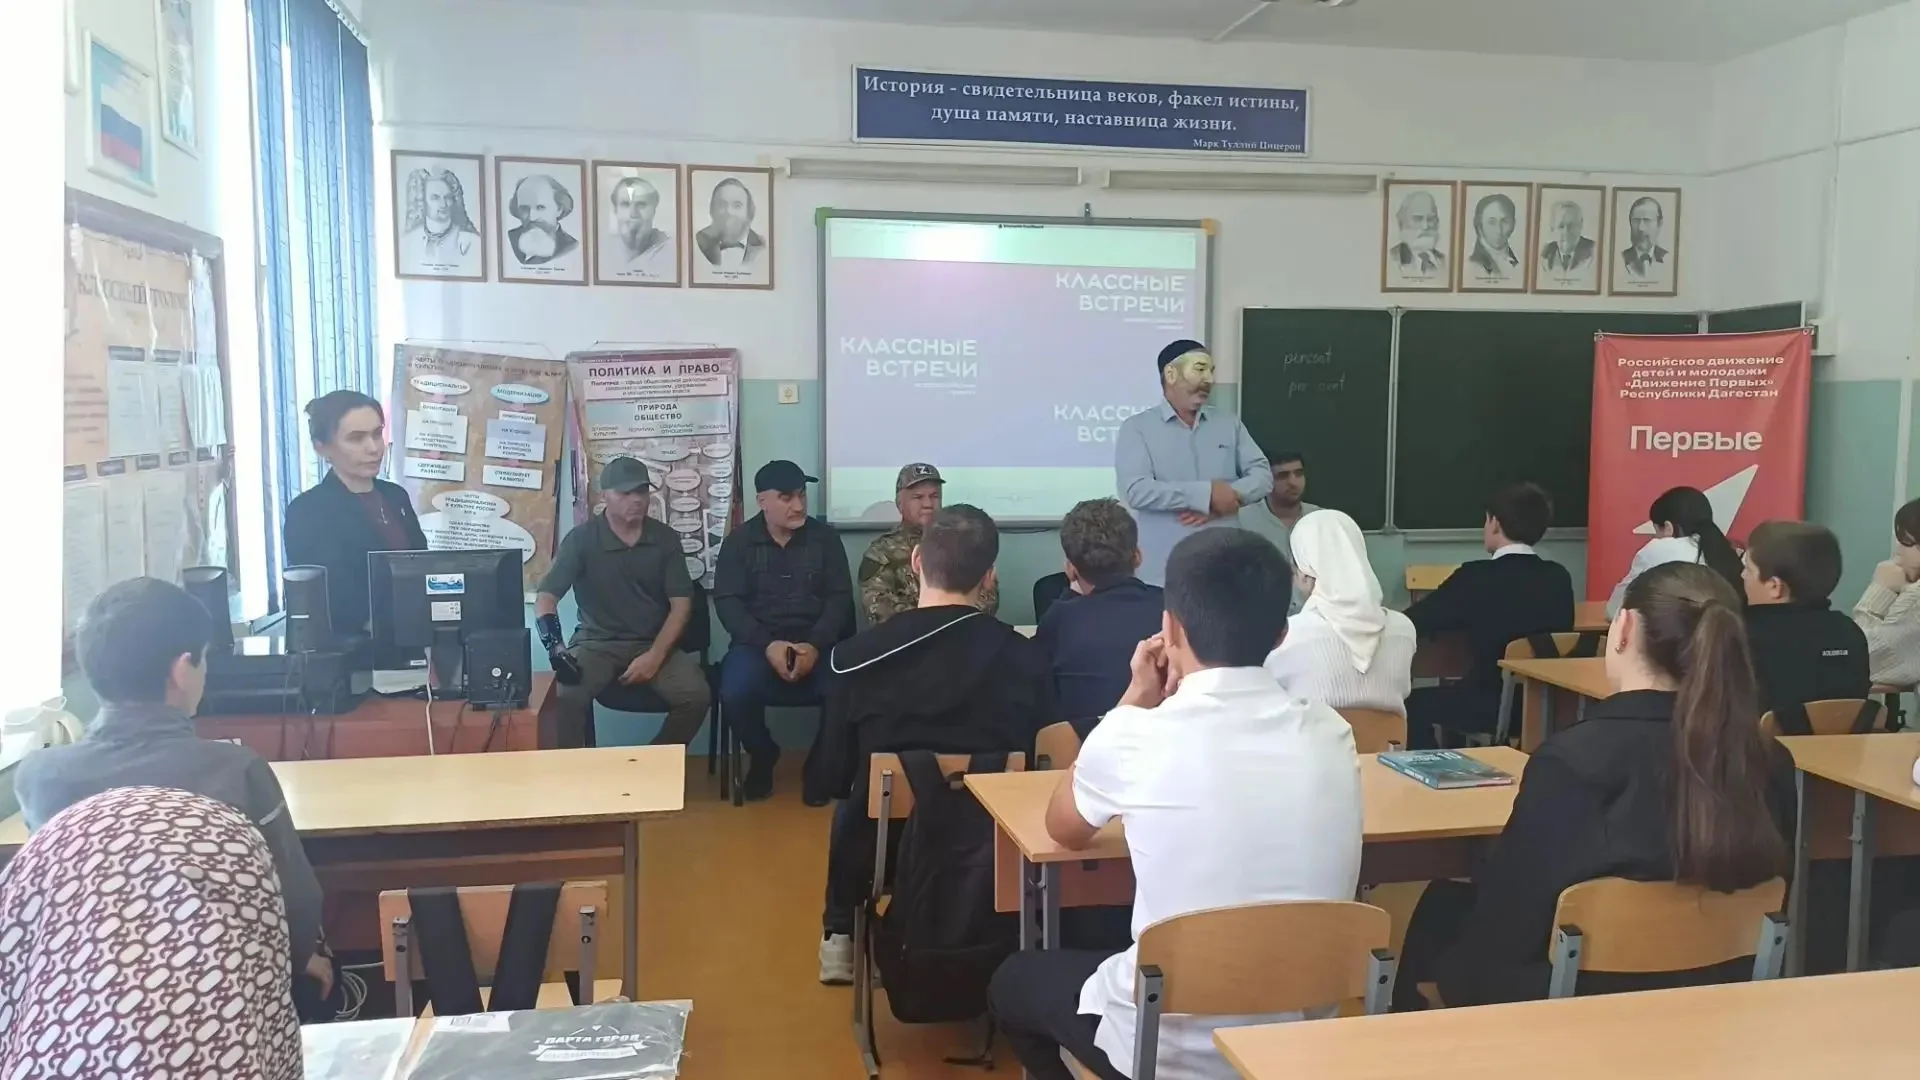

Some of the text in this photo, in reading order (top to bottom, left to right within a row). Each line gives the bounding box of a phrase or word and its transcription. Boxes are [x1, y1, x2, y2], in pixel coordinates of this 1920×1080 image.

[863, 75, 945, 96] История
[962, 82, 1101, 103] свидетельница
[1107, 90, 1162, 107] веков,
[1168, 88, 1223, 109] факел
[1229, 96, 1300, 111] истины,
[931, 106, 1237, 131] душа памяти, наставница жизни.
[1192, 138, 1301, 152] Марк Туллий Цицерон
[1055, 272, 1186, 293] КЛАССНЫЕ
[1079, 295, 1185, 314] ВСТРЕЧИ
[840, 336, 977, 357] КЛАССНЫЕ
[1617, 356, 1785, 367] Российское движение
[589, 364, 720, 377] ПОЛИТИКА И ПРАВО
[866, 360, 978, 379] ВСТРЕЧИ
[1631, 368, 1674, 378] детей
[1689, 368, 1768, 377] молодежи
[1625, 378, 1774, 388] «Движение Первых»
[1619, 389, 1779, 400] Республики Дагестан
[634, 413, 682, 421] ОБЩЕСТВО
[1630, 425, 1764, 458] Первые
[919, 465, 928, 475] Z
[544, 1036, 591, 1045] ПАРТА
